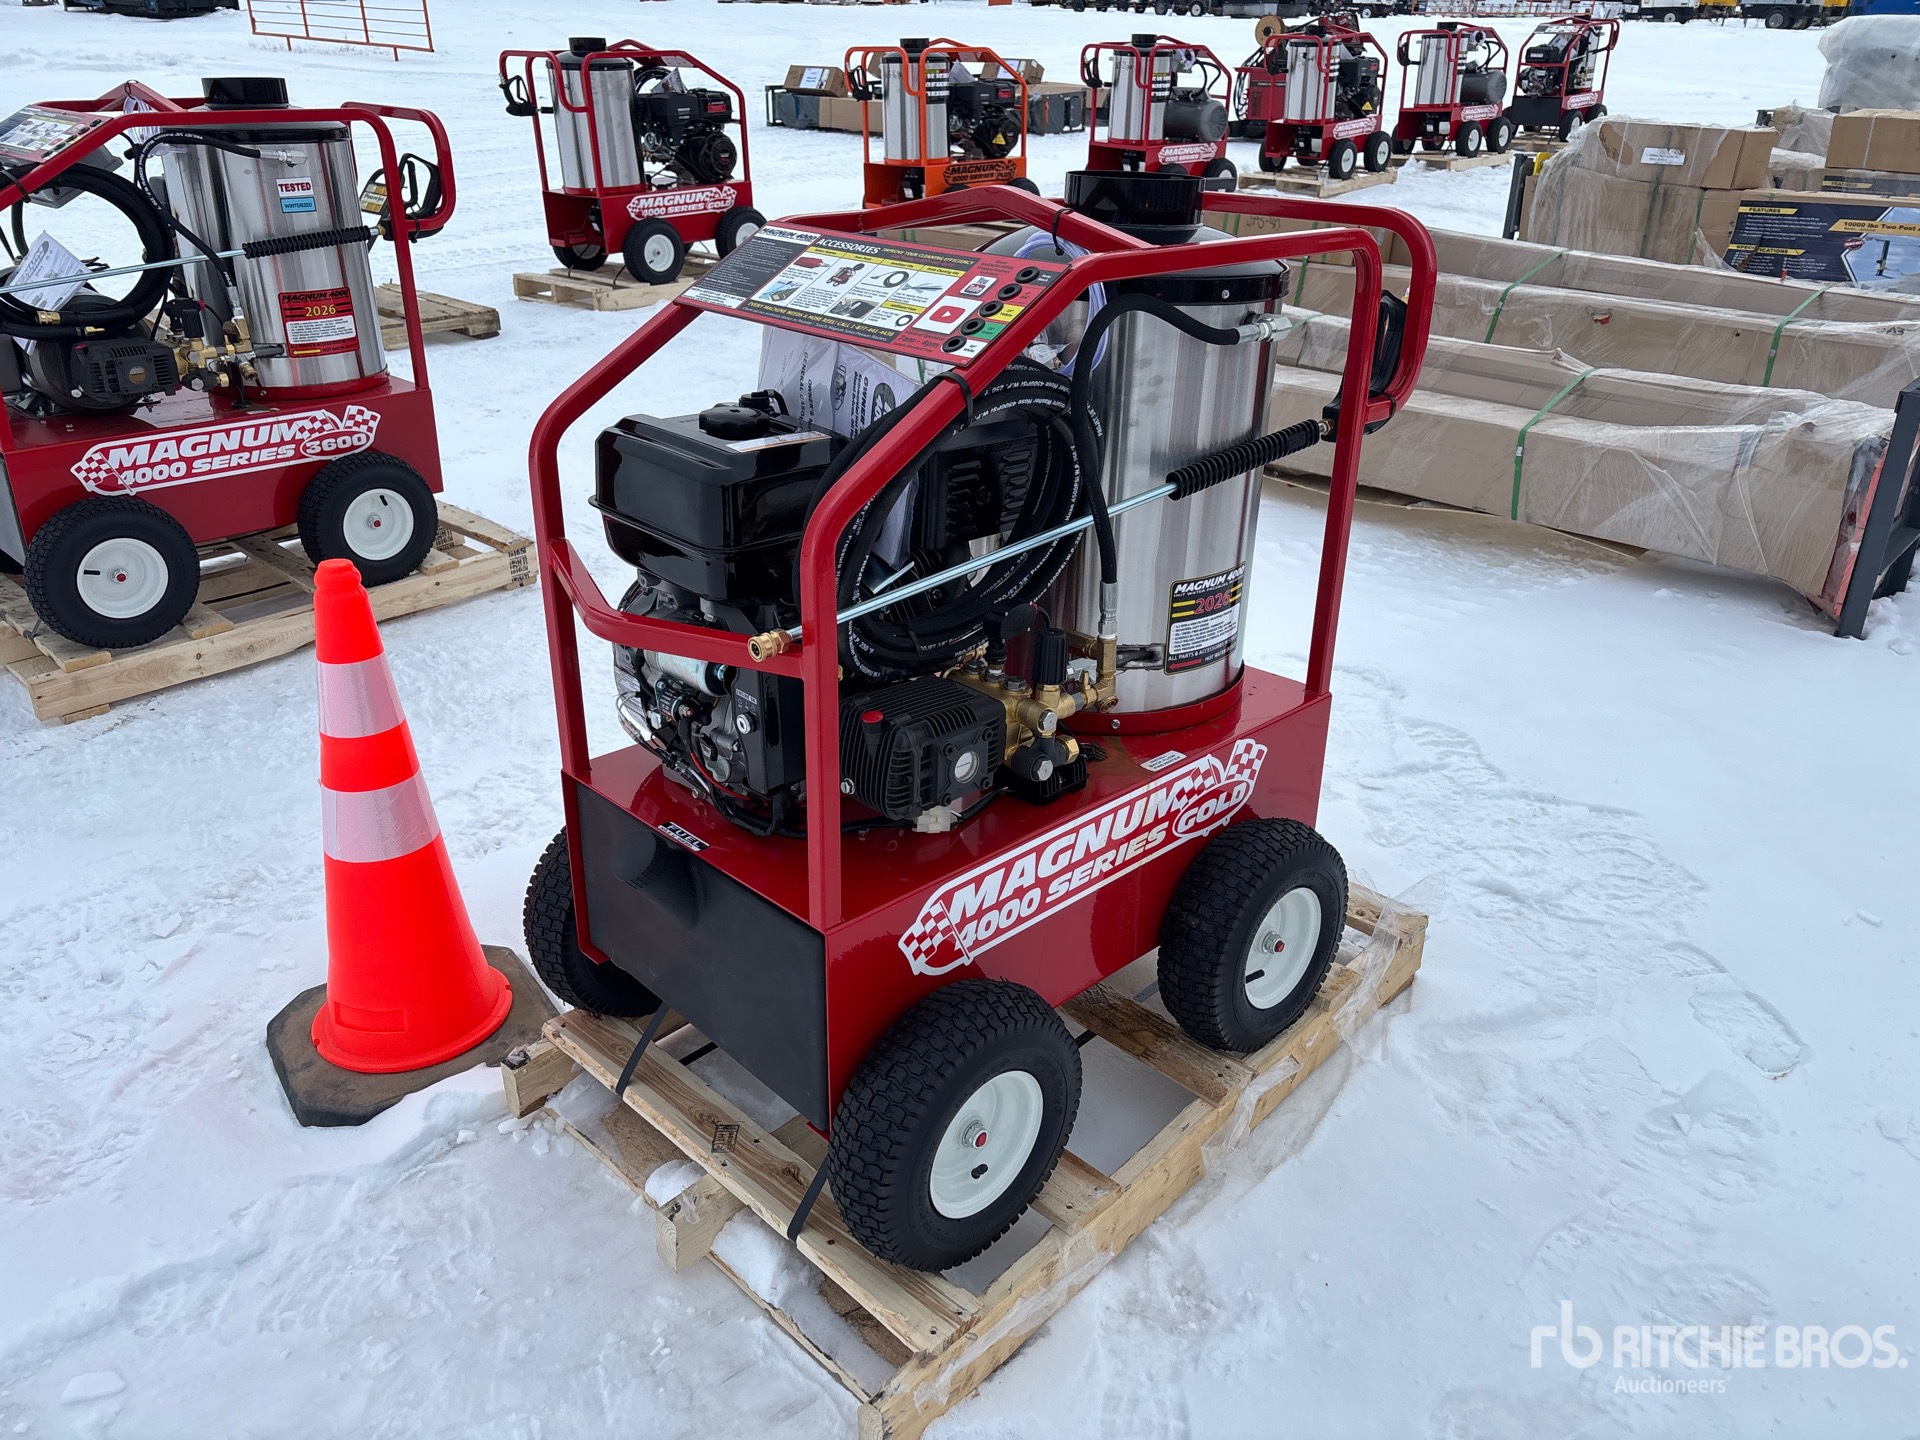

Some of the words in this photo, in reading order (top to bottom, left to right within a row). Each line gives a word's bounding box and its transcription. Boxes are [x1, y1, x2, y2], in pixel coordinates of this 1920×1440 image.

[950, 163, 998, 175] MAGNUM
[969, 172, 994, 181] SERIES
[278, 182, 311, 193] TESTED
[639, 191, 709, 209] MAGNUM
[642, 207, 666, 217] 4000
[667, 203, 705, 214] SERIES
[707, 200, 732, 209] GOLD
[816, 238, 881, 254] ACCESSORIES
[918, 252, 944, 261] CLEANING
[943, 256, 974, 265] EFFICIENCY
[966, 284, 985, 293] Tube
[977, 276, 990, 285] You
[282, 292, 327, 301] MAGNUM
[329, 289, 348, 298] 4000
[304, 304, 336, 317] 2026
[748, 301, 763, 309] EVERY
[764, 304, 787, 313] MACHINE
[823, 317, 837, 325] REEL!
[837, 320, 850, 328] CALL
[850, 323, 894, 337] 1-877-441-4430
[900, 335, 916, 343] 7am
[921, 339, 939, 348] 4pm
[924, 333, 946, 341] Operation
[799, 351, 808, 392] GENERAL
[991, 384, 1005, 392] 250
[1045, 381, 1059, 390] Hose
[855, 374, 863, 415] Commercial
[1033, 398, 1053, 406] Washer
[990, 401, 1017, 414] 4500PSI
[1092, 414, 1103, 437] PROJET
[106, 420, 311, 469] MAGNUM
[117, 461, 187, 486] 4000
[191, 444, 296, 473] SERIES
[305, 432, 367, 454] 3600
[1065, 504, 1074, 521] Hose
[1071, 476, 1080, 502] 4500PSI
[837, 535, 852, 569] Pressure
[855, 554, 870, 586] PROJET
[993, 584, 1018, 604] PROJET
[1030, 547, 1053, 577] Pressure
[1033, 588, 1047, 603] Hose
[1047, 561, 1066, 588] 4500PSI
[1074, 532, 1084, 546] 250
[1174, 574, 1227, 594] MAGNUM
[1206, 582, 1228, 592] PRESSURE
[1194, 589, 1231, 615] 2026
[859, 641, 869, 652] 250
[955, 644, 976, 658] PROJET
[1178, 651, 1195, 660] PARTS
[1199, 640, 1226, 655] ACCESSORIES
[1153, 755, 1181, 770] PREVENTER
[667, 825, 700, 848] FUEL
[948, 776, 1194, 924] MAGNUM
[954, 888, 1042, 951] 4000
[1046, 821, 1169, 903] SERIES
[1177, 782, 1247, 833] GOLD
